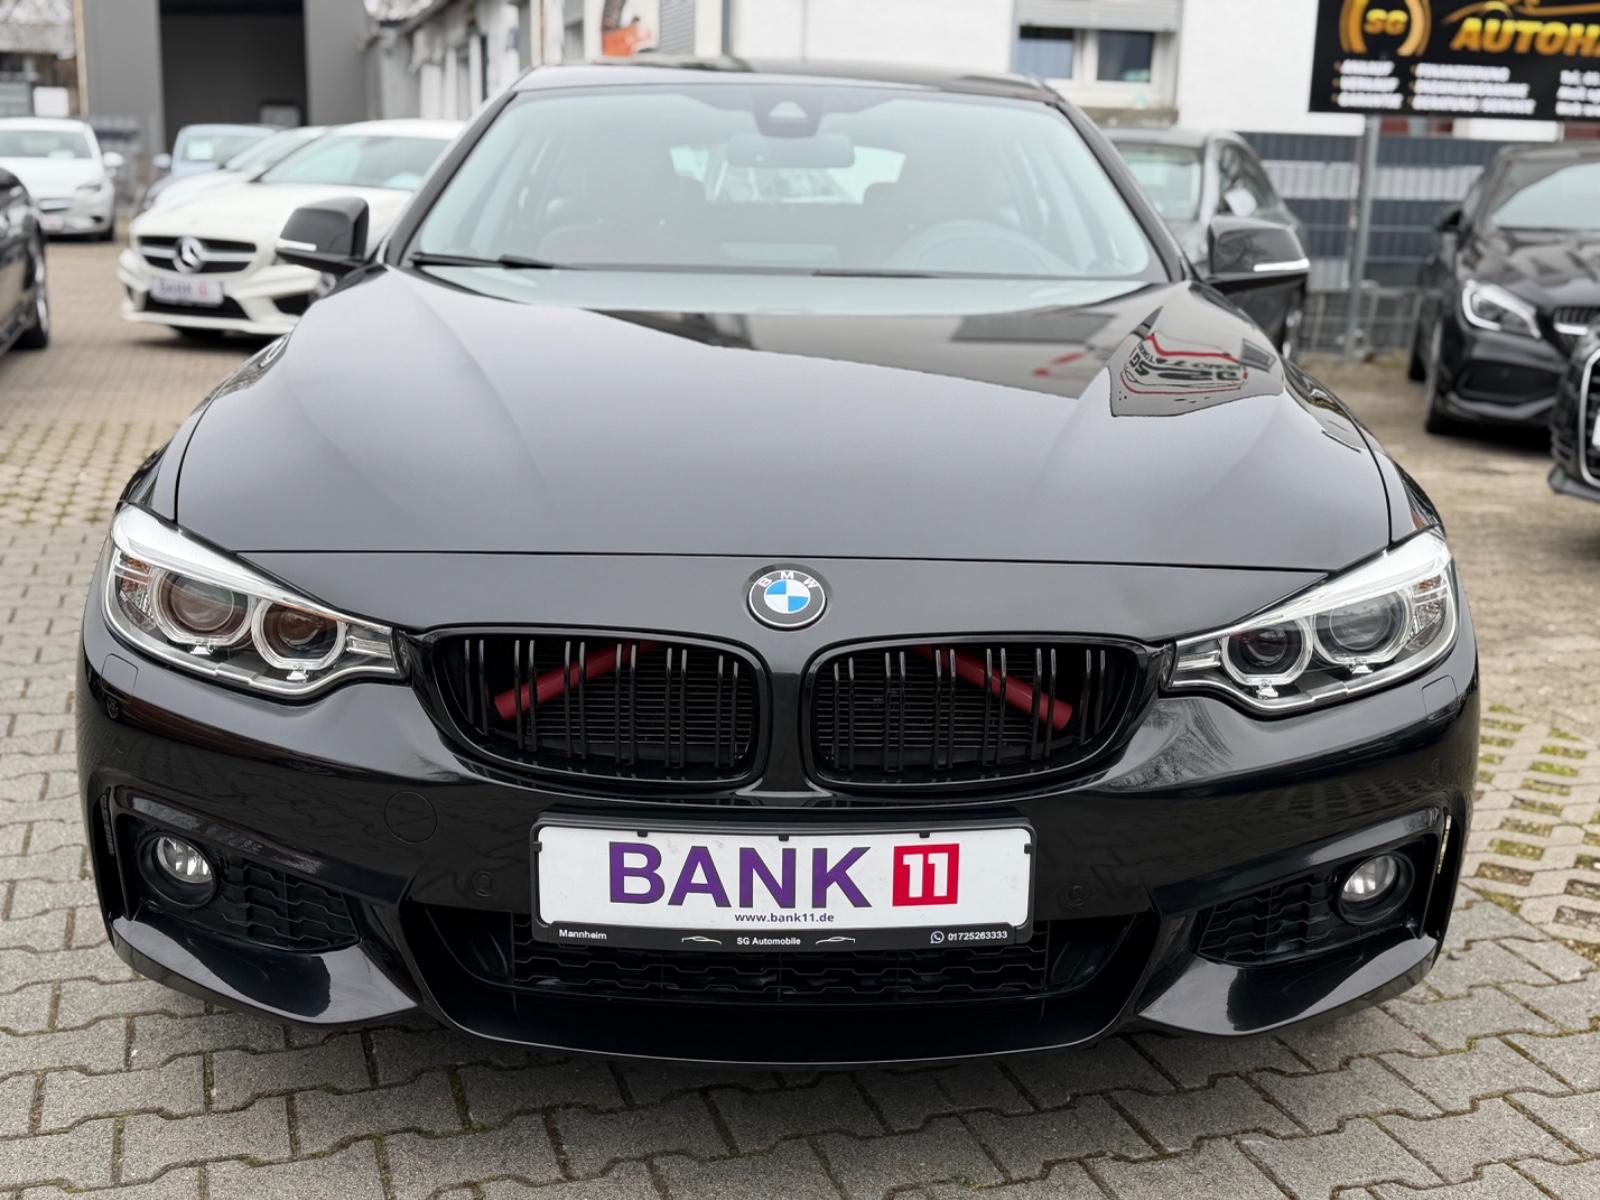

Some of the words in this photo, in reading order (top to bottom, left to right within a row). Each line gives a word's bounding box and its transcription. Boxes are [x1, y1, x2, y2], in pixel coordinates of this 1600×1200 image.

[1364, 8, 1408, 35] SG
[1449, 17, 1600, 57] AUTOH
[758, 569, 819, 588] BMW
[609, 841, 872, 908] BANK
[901, 851, 950, 899] 11
[734, 912, 835, 923] www.bank11.de
[558, 929, 607, 940] Mannheim
[736, 936, 750, 945] SG
[752, 936, 801, 946] Automobile
